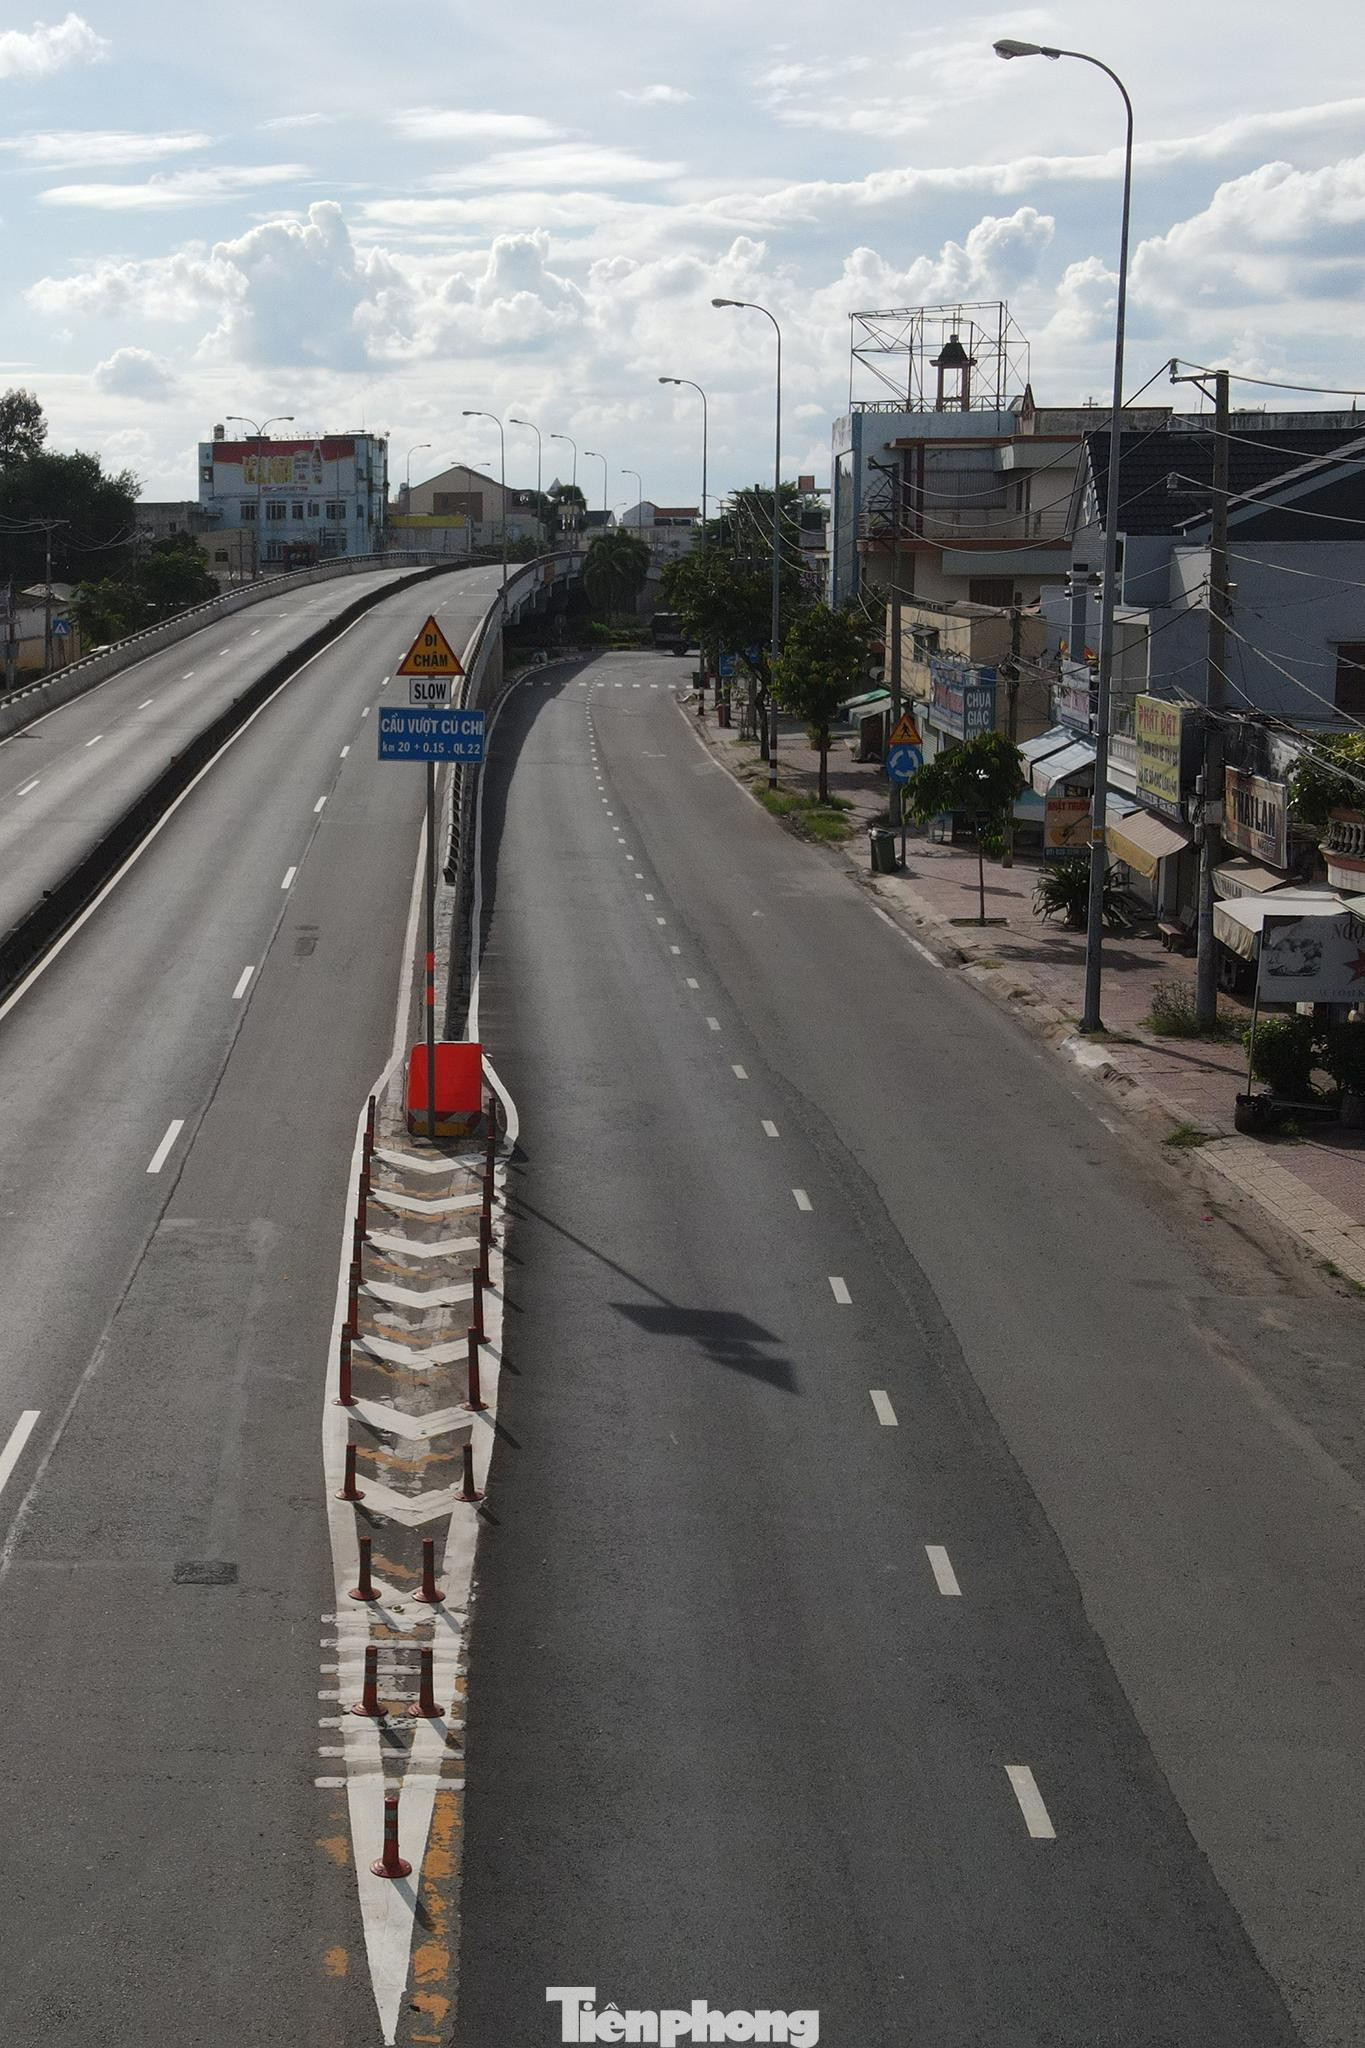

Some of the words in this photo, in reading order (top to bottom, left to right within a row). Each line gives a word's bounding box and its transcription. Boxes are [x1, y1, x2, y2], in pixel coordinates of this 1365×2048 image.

[425, 634, 437, 647] ĐI
[413, 652, 448, 669] CHẬM
[414, 683, 447, 700] SLOW
[966, 689, 991, 708] CHÙA
[381, 713, 404, 733] CẦU
[408, 717, 438, 737] VƯỢT
[461, 720, 483, 736] CHI
[967, 708, 989, 726] GIÁC
[382, 741, 395, 752] km
[398, 742, 410, 753] 20
[423, 742, 444, 753] 0.15
[453, 743, 465, 754] QL
[467, 744, 480, 754] 22
